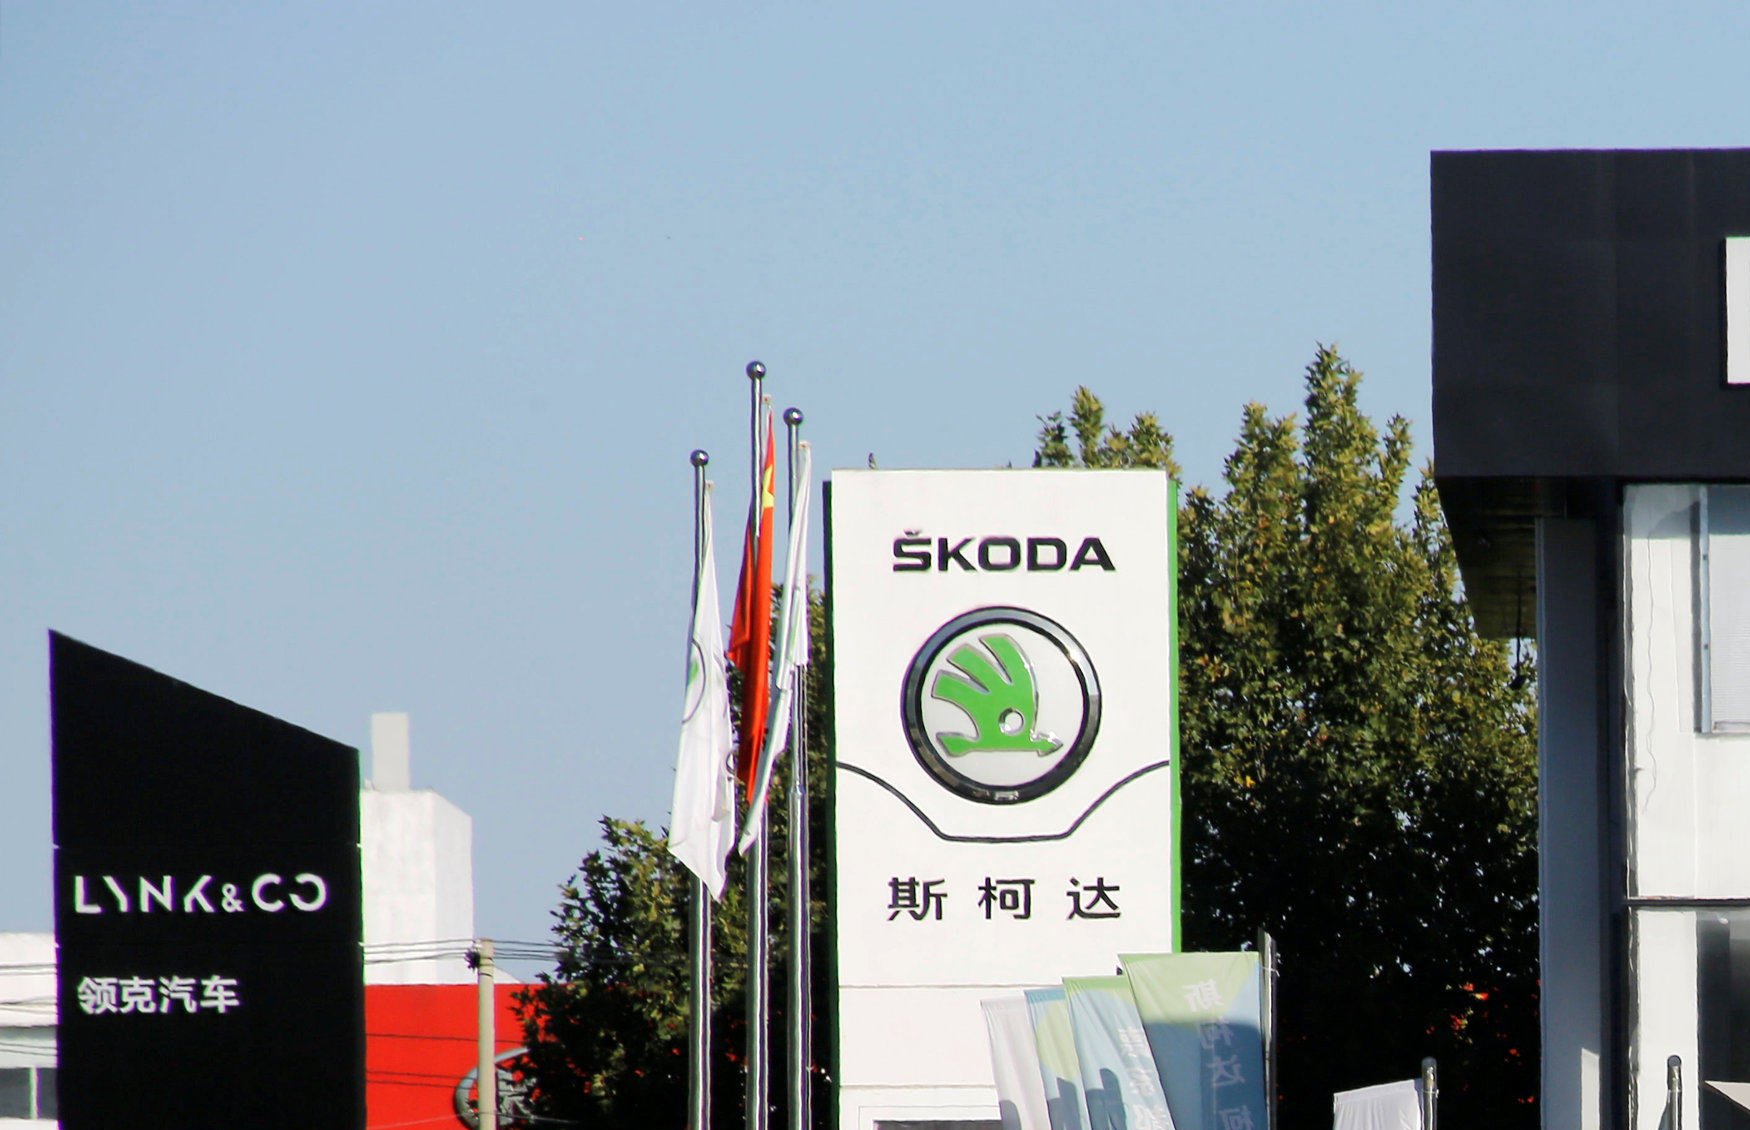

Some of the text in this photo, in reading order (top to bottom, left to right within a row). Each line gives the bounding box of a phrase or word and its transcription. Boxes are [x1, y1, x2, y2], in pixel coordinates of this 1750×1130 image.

[893, 530, 1116, 571] ŠKODA
[889, 877, 1120, 920] 斯柯达
[78, 975, 240, 1014] 领克汽车
